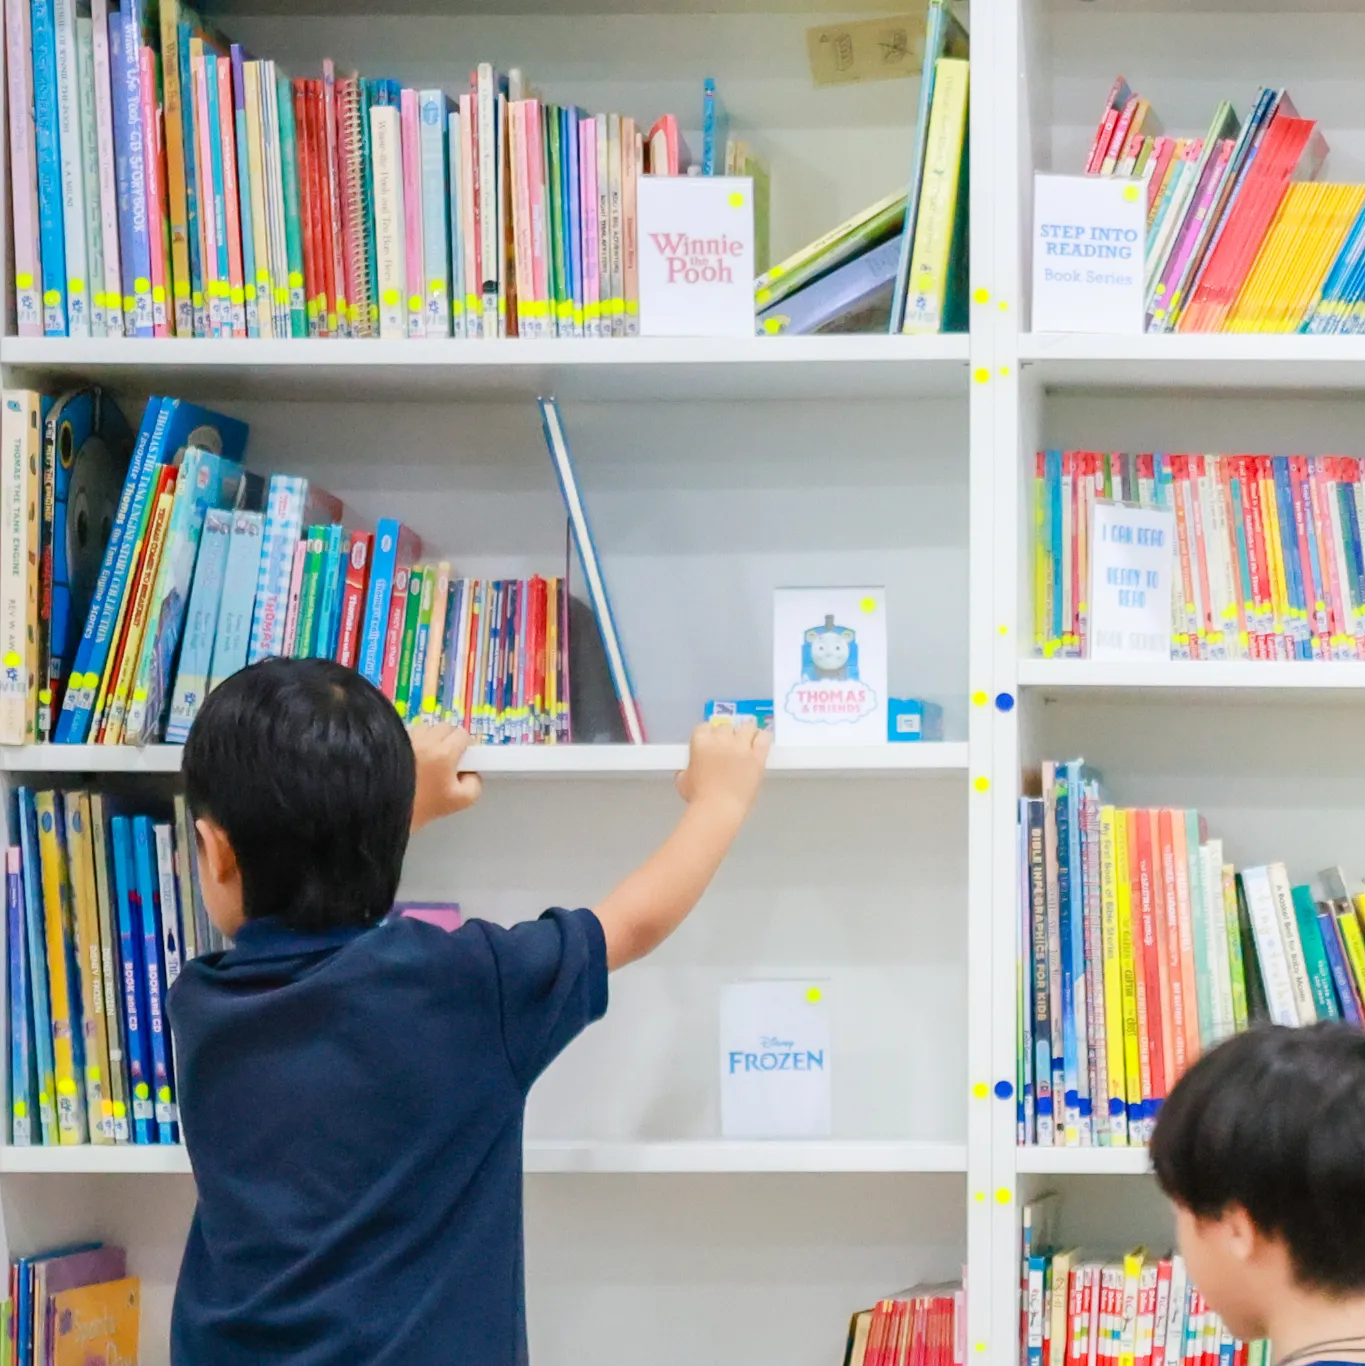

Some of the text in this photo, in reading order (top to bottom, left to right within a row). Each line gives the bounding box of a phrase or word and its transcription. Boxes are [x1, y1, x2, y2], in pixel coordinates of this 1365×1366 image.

[647, 233, 744, 257] Winnie
[1041, 224, 1138, 242] STEP INTO
[1046, 242, 1132, 259] READING
[667, 257, 734, 283] Pooh
[1044, 268, 1132, 286] Book Series
[141, 452, 157, 474] THE
[133, 476, 151, 502] TANK
[122, 503, 144, 541] ENGINE
[259, 594, 277, 649] THOMAS
[343, 593, 357, 631] Thomas
[796, 689, 865, 704] THOMAS
[1030, 827, 1046, 1021] BIBLE INFOGRAPHICS FOR KIDS
[123, 962, 138, 1031] BOOK and CD
[147, 964, 161, 1033] BOOK and CD
[728, 1049, 824, 1075] FROZEN
